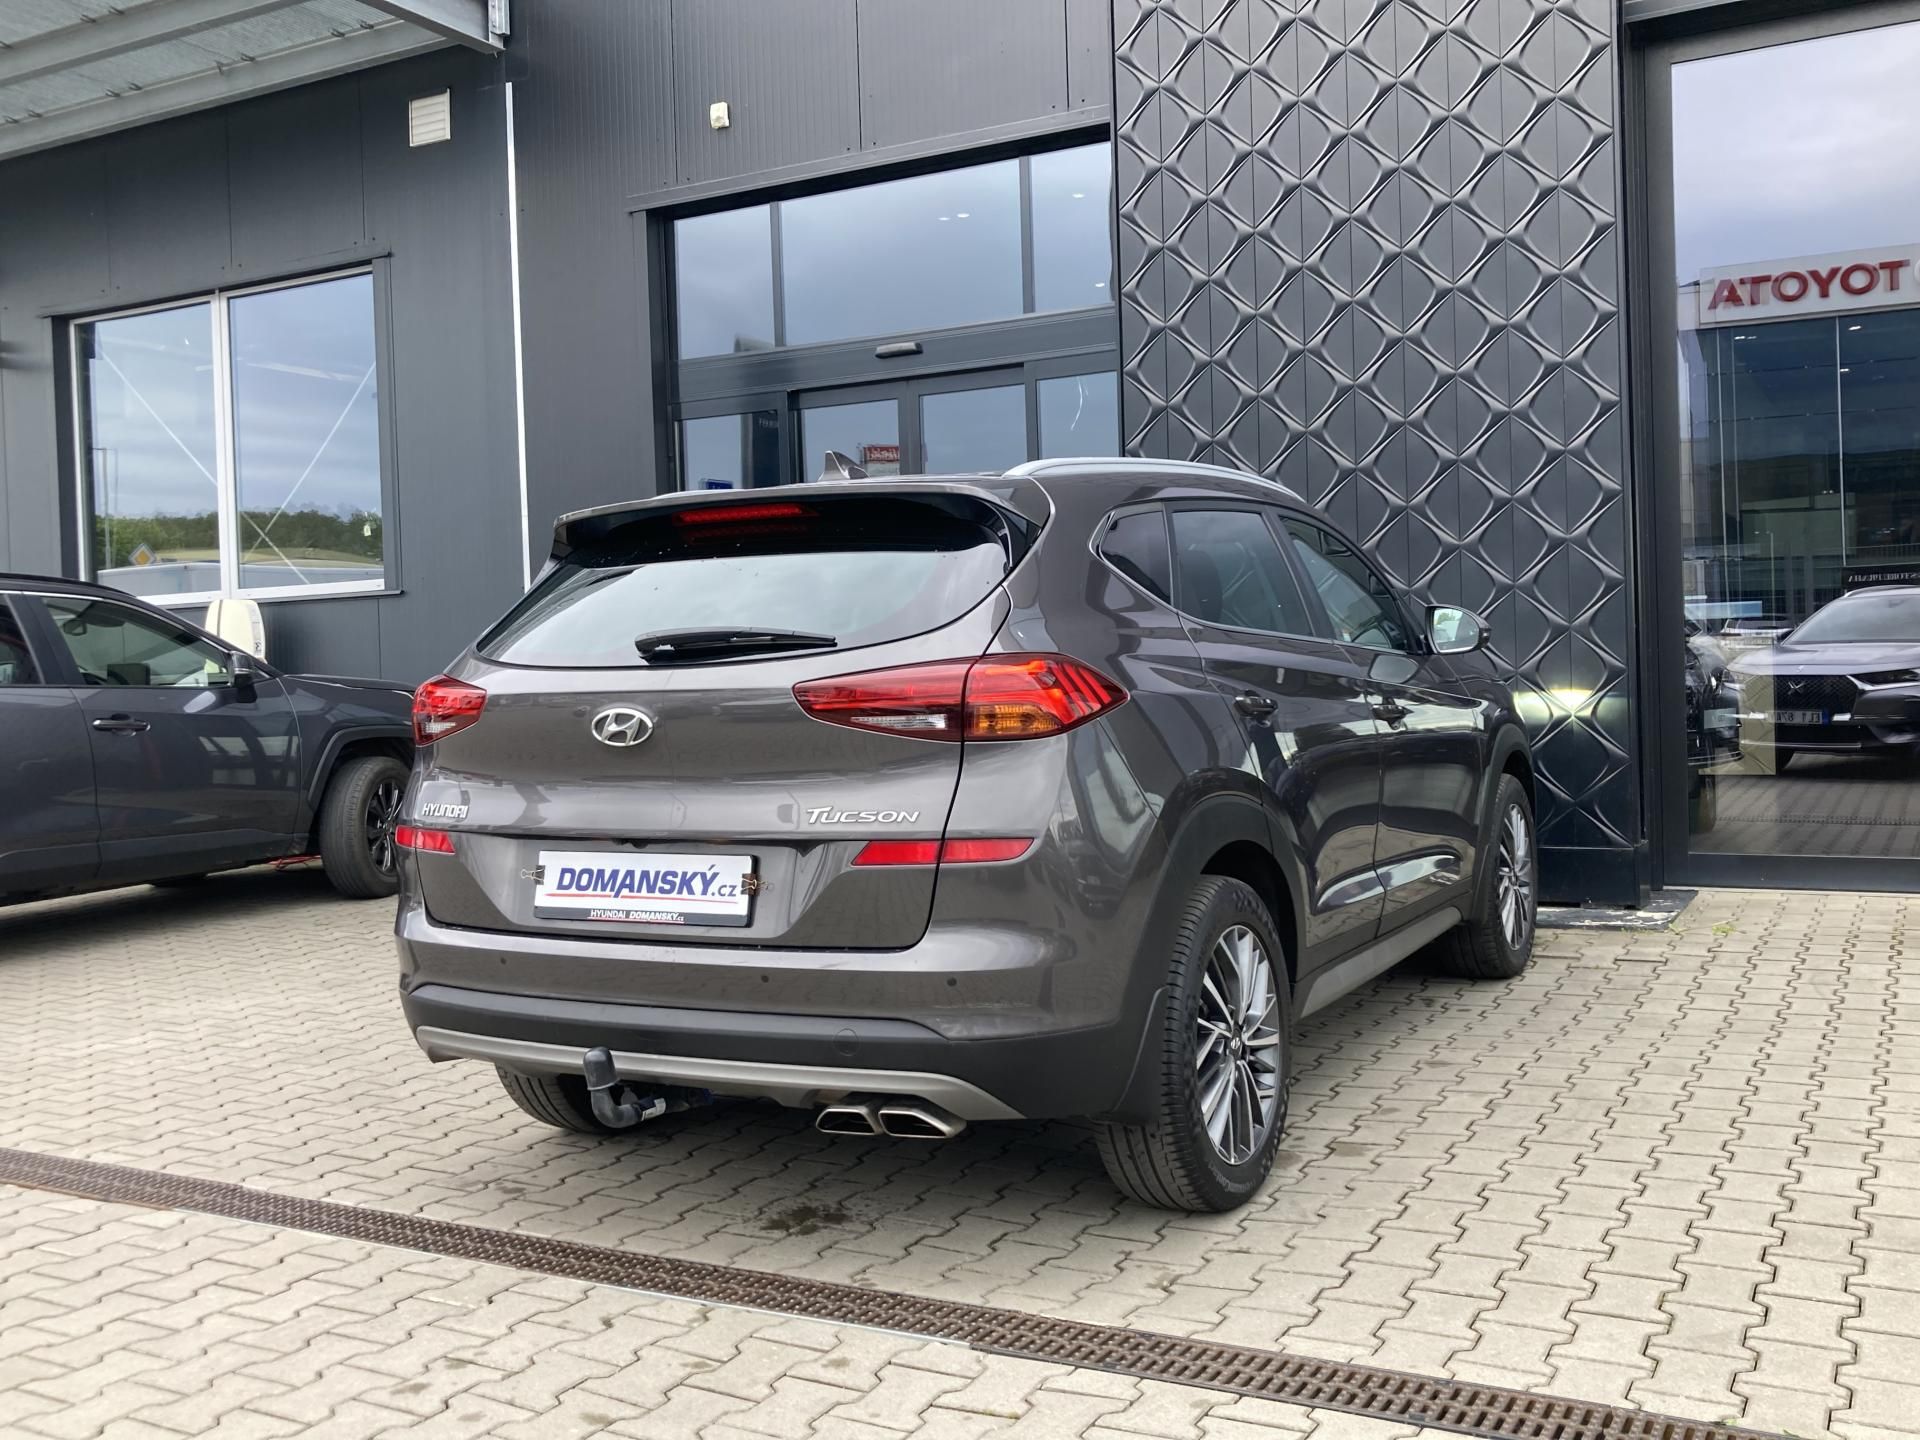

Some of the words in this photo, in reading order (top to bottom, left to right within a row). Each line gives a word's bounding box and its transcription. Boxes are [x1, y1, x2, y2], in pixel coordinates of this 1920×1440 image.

[422, 803, 469, 818] HYUNDAI
[807, 806, 920, 824] TUCSON
[590, 909, 626, 918] HYUNDAI
